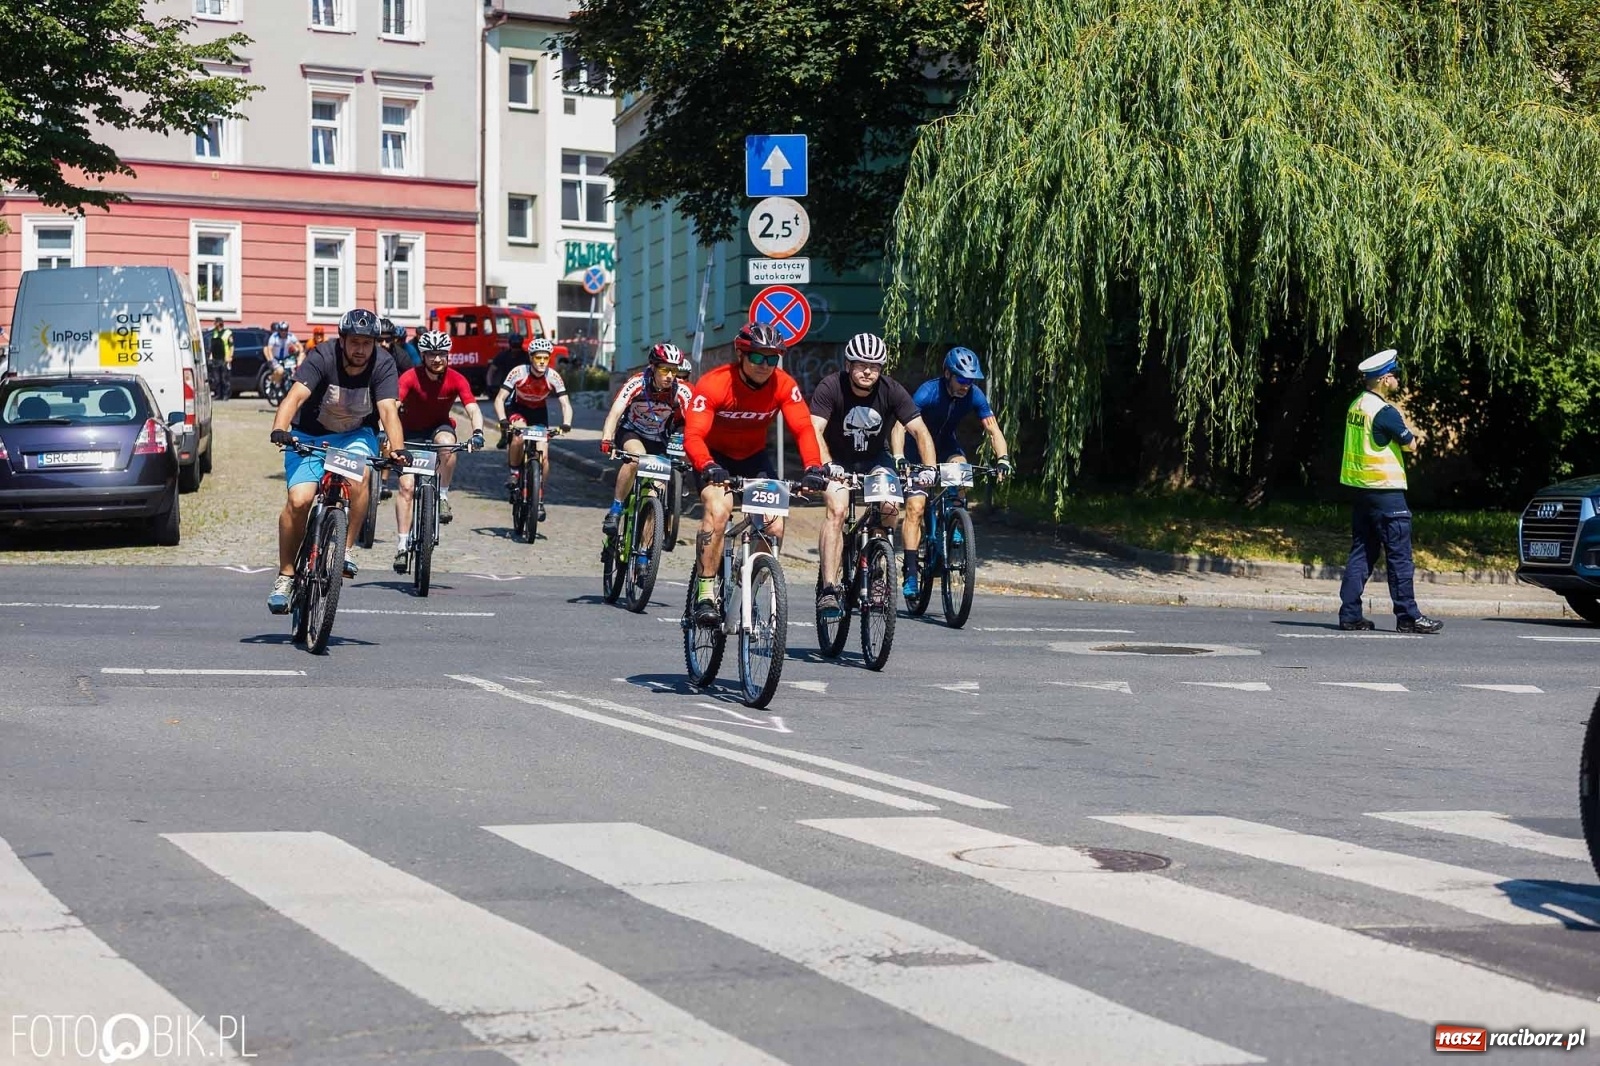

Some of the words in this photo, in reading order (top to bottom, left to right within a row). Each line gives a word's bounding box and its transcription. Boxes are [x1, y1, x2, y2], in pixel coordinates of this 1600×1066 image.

[752, 262, 768, 270] Nie
[771, 261, 805, 271] dotyczy
[754, 272, 802, 281] autokarów
[116, 313, 153, 324] OUT
[52, 330, 93, 342] InPost
[116, 326, 141, 337] OF
[117, 339, 153, 350] THE
[117, 352, 154, 363] BOX
[45, 453, 68, 463] SRC
[333, 455, 358, 470] 2216
[645, 461, 664, 471] 2011
[751, 490, 780, 505] 2591
